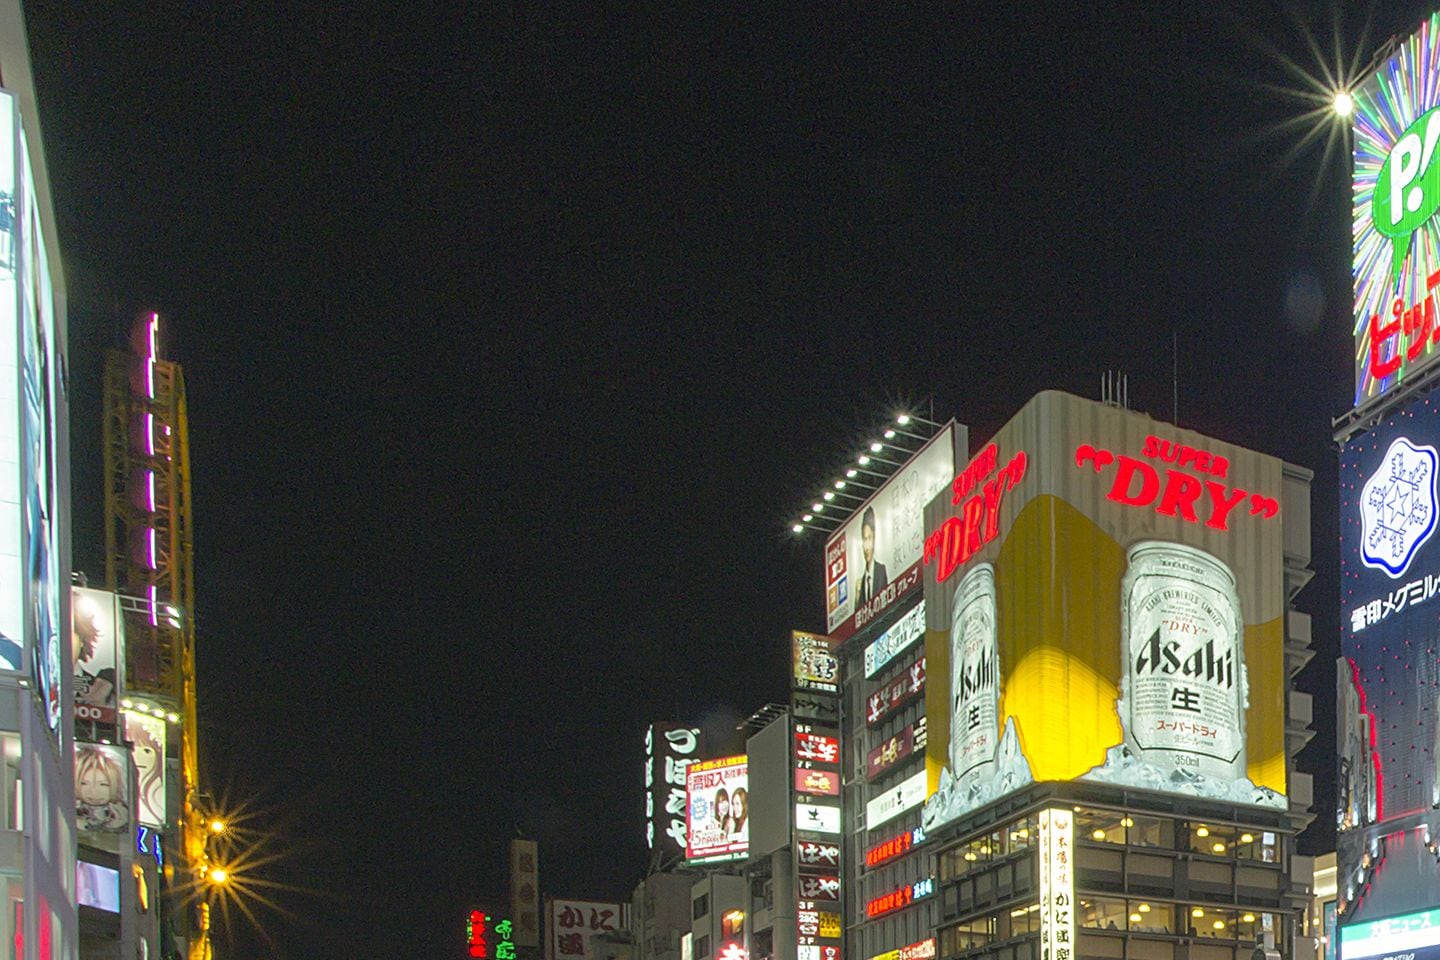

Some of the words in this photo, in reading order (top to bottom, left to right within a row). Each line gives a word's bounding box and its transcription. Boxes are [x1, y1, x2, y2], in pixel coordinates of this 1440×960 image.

[952, 443, 998, 505] SUPER
[1142, 434, 1230, 479] SUPER
[1135, 627, 1233, 690] Asahi
[954, 645, 995, 713] Asahi
[968, 704, 981, 730] 生
[1171, 687, 1202, 713] 生
[1156, 719, 1218, 741] スーパードライ
[557, 905, 615, 931] かに
